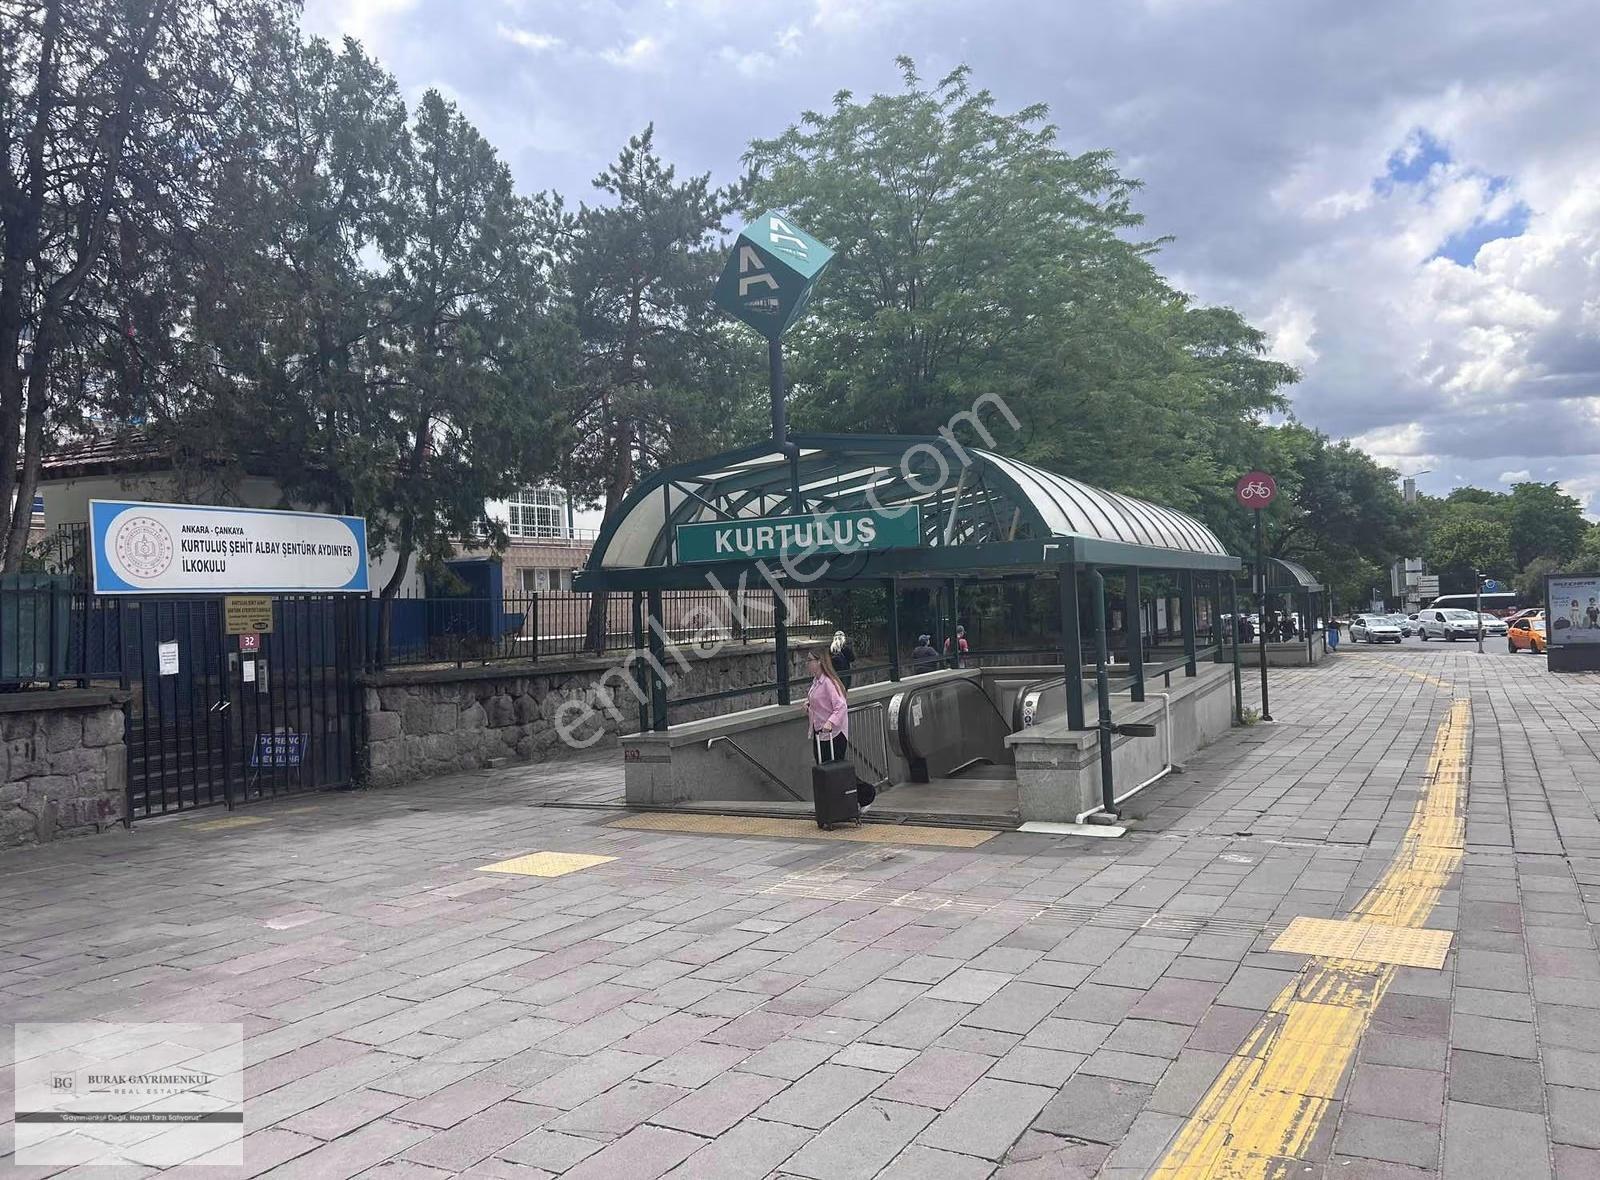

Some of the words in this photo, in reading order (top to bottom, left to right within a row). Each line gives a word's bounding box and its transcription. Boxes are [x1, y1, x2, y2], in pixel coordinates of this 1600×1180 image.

[181, 525, 210, 534] ANKARA
[214, 526, 245, 536] ÇANKAYA
[715, 517, 877, 553] KURTULUŞ
[181, 539, 227, 557] KURTULUŞ
[229, 537, 253, 557] ŞEHİT
[255, 541, 280, 554] ALBAY
[281, 540, 317, 558] ŞENTÜRK
[318, 543, 353, 557] AYDINYER
[182, 556, 226, 573] İLKOKULU
[244, 636, 255, 646] 32
